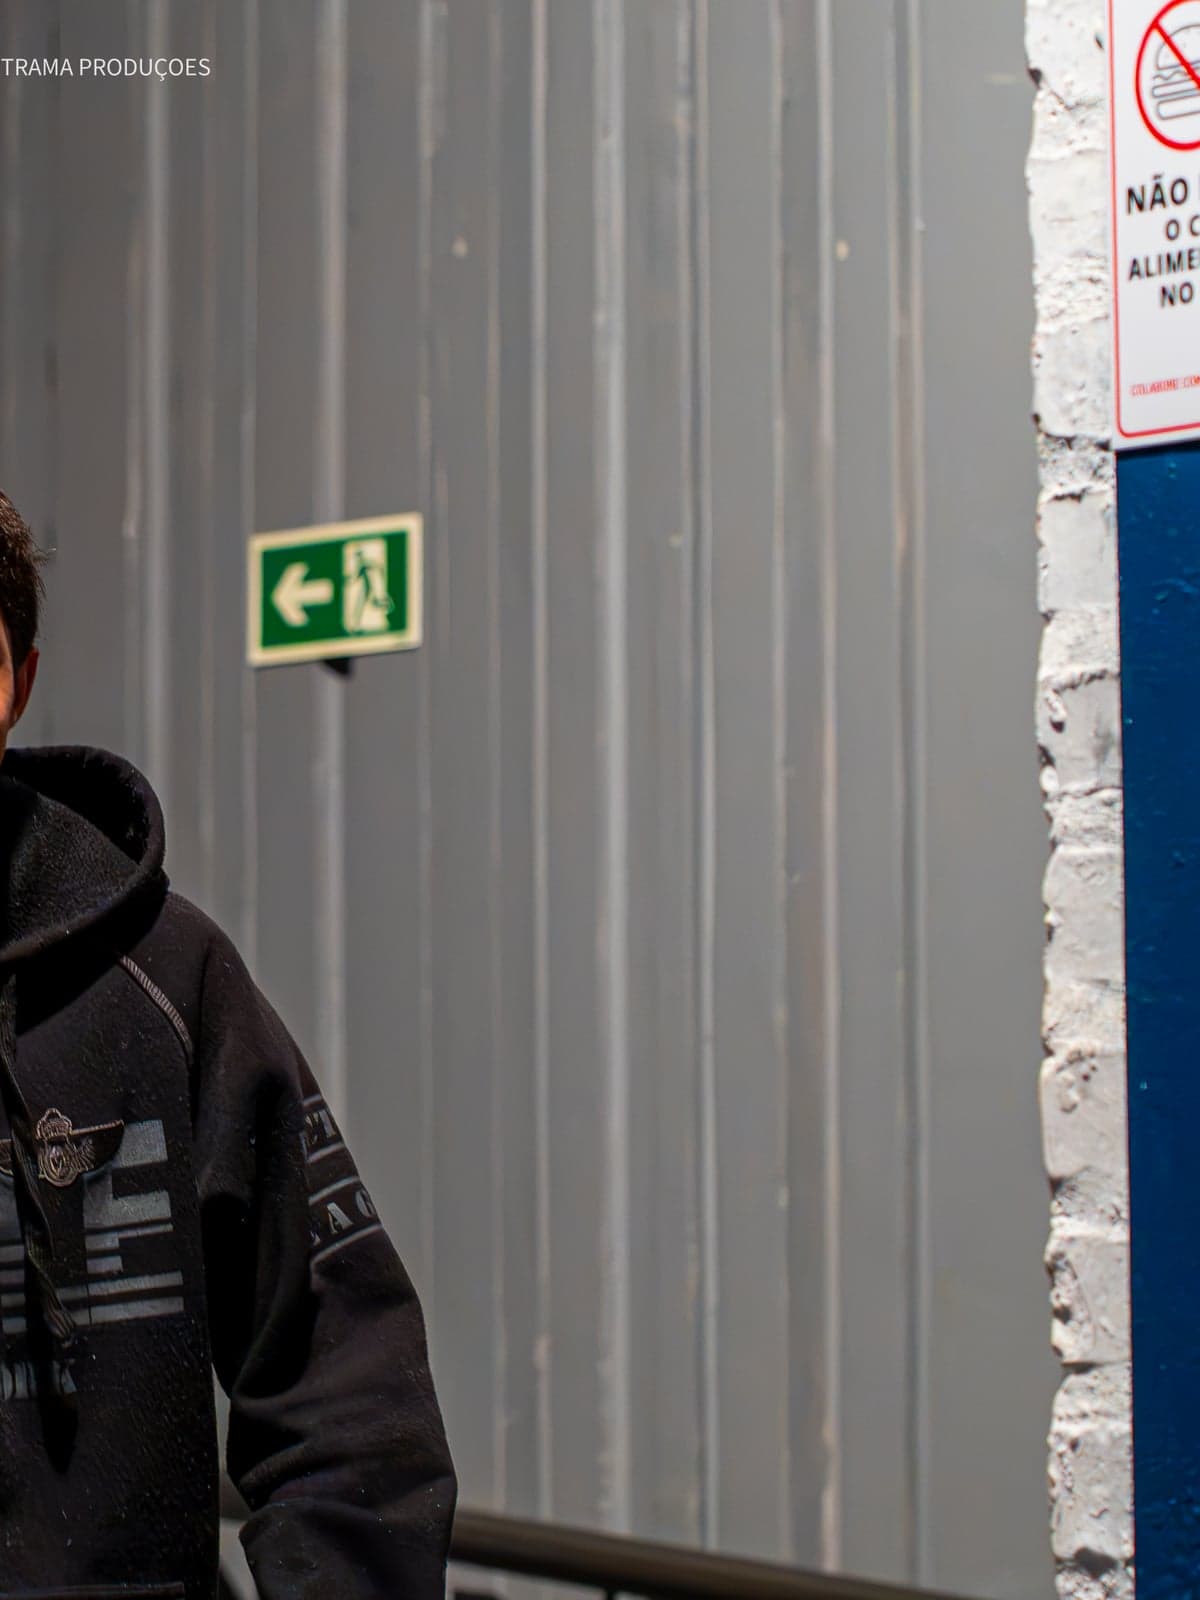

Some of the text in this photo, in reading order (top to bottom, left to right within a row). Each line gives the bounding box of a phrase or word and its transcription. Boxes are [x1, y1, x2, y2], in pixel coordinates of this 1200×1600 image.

[1126, 174, 1189, 215] NÃO
[1166, 218, 1180, 241] O
[1160, 281, 1194, 308] NO
